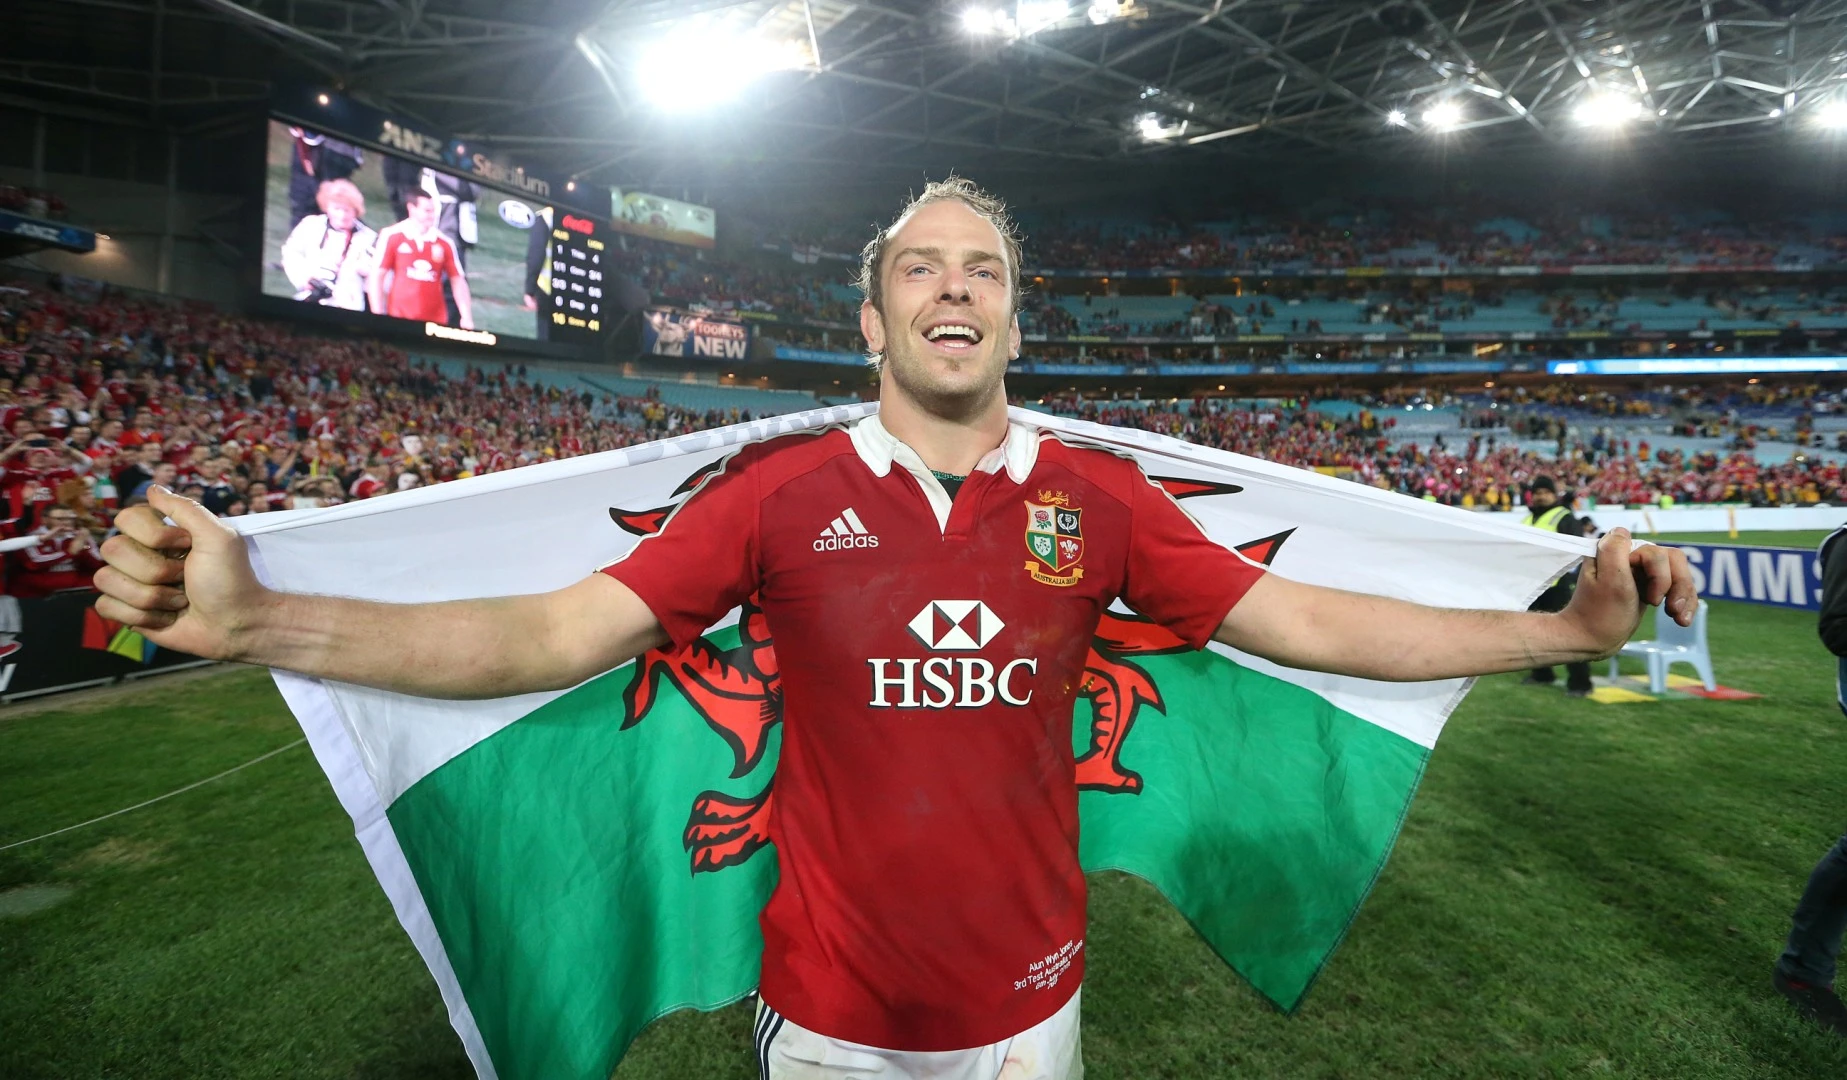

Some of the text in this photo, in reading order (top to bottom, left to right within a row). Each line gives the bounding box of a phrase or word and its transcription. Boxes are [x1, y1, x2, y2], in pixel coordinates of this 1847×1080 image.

[379, 121, 549, 197] ANZ Stadium
[693, 335, 747, 359] NEW
[813, 534, 879, 552] adidas
[1033, 572, 1066, 585] AUSTRALIA
[866, 657, 1038, 710] HSBC
[1029, 939, 1073, 973] Alun Wyn Jones
[1014, 977, 1027, 990] 3rd
[1027, 971, 1044, 984] Test
